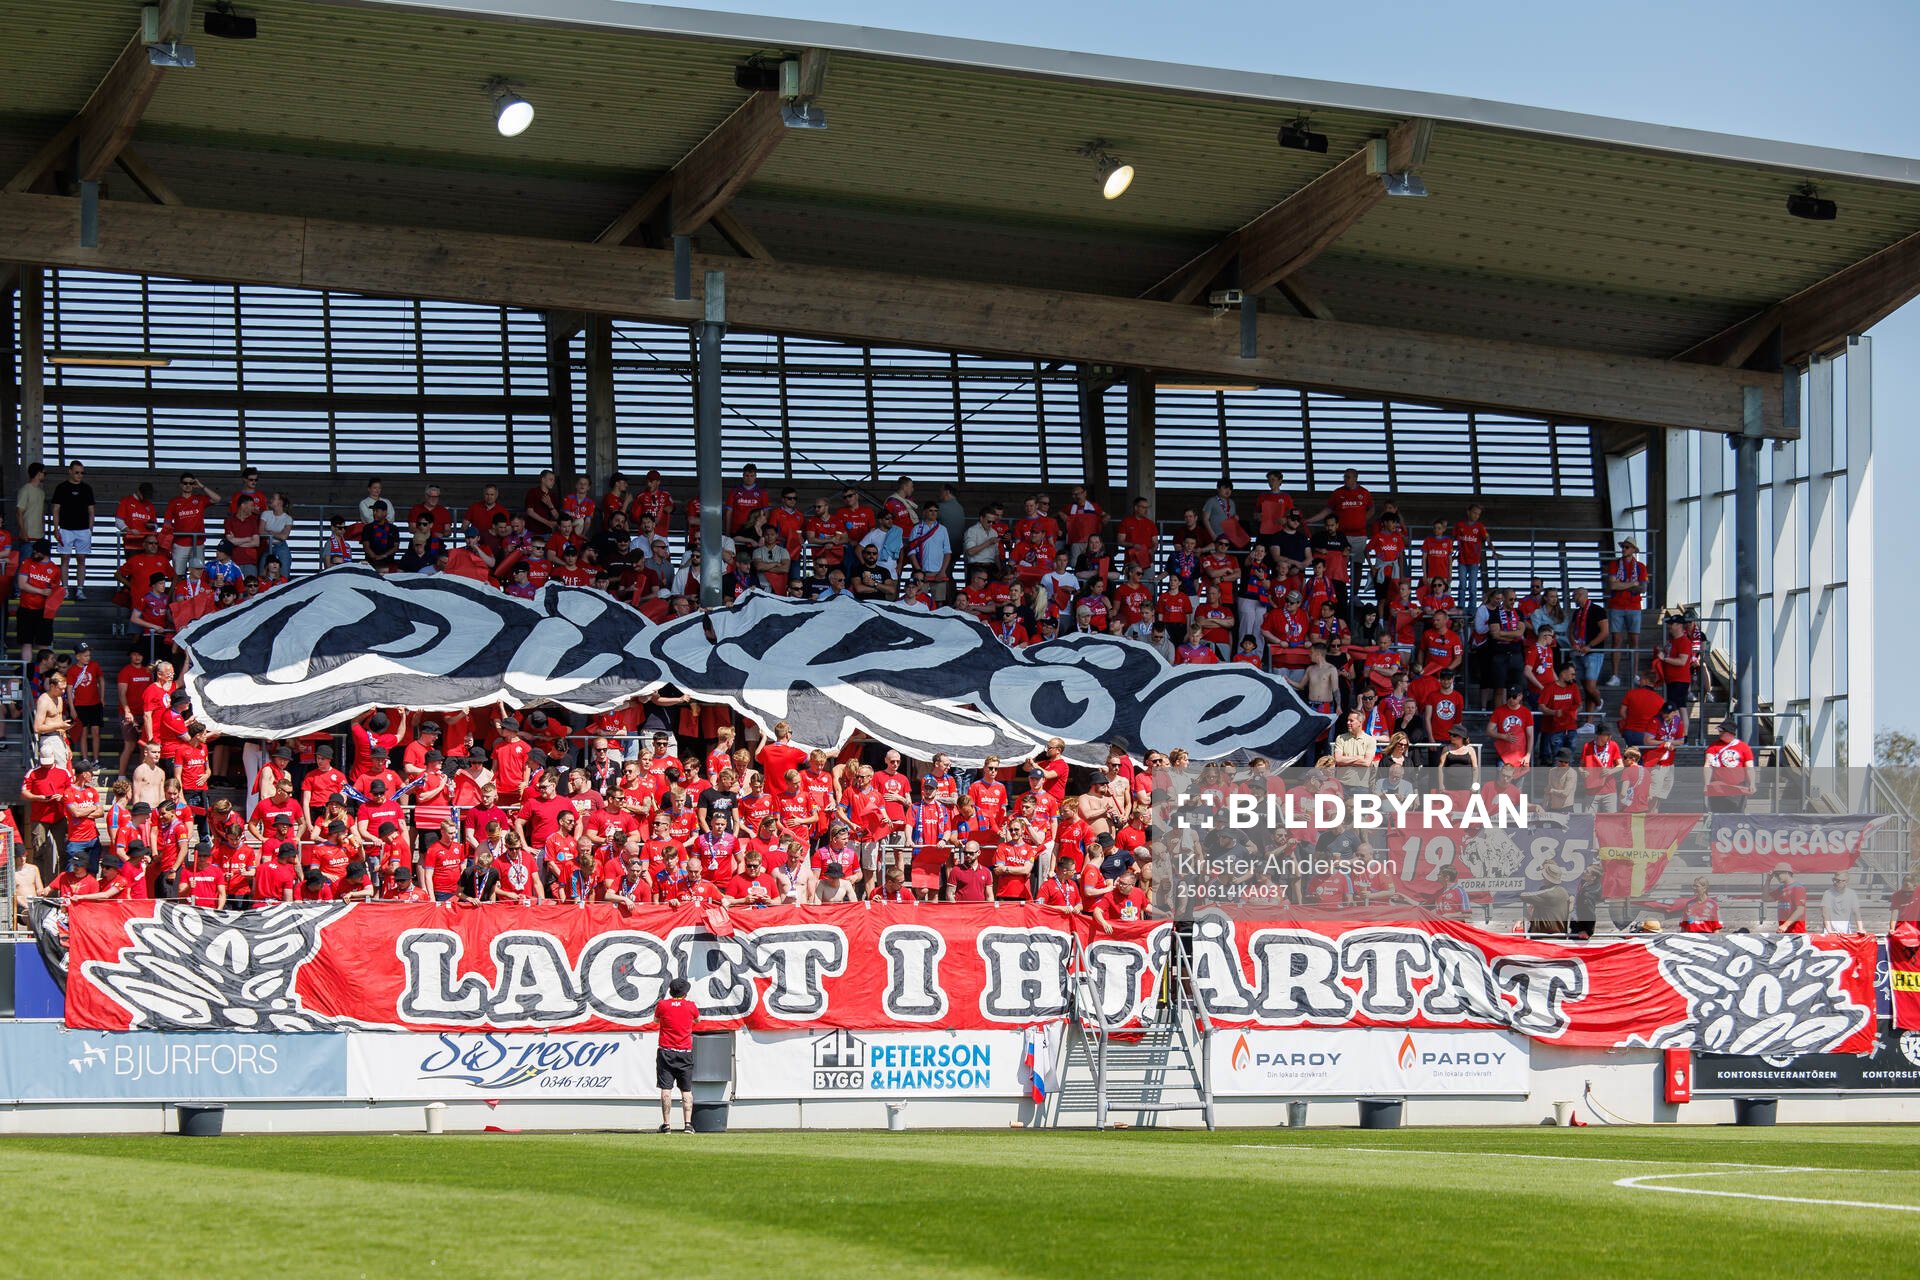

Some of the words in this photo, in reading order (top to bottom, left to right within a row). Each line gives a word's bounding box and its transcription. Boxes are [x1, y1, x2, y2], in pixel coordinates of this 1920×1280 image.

[1400, 836, 1455, 882] 19
[1525, 836, 1590, 882] 85
[397, 924, 848, 1028] LAGET
[879, 924, 949, 1023] I
[977, 907, 1590, 1038] HJÄRTAT
[114, 1044, 278, 1081] BJURFORS
[871, 1044, 990, 1067] PETERSON
[1256, 1052, 1342, 1066] PAROY
[1422, 1051, 1506, 1065] PAROY
[540, 1076, 612, 1088] 0346-13027
[814, 1071, 864, 1089] BYGG
[871, 1069, 990, 1089] &HANSSON
[1717, 1069, 1837, 1079] KONTORSLEVERANTÖREN
[1862, 1070, 1920, 1079] KONTORSLE
